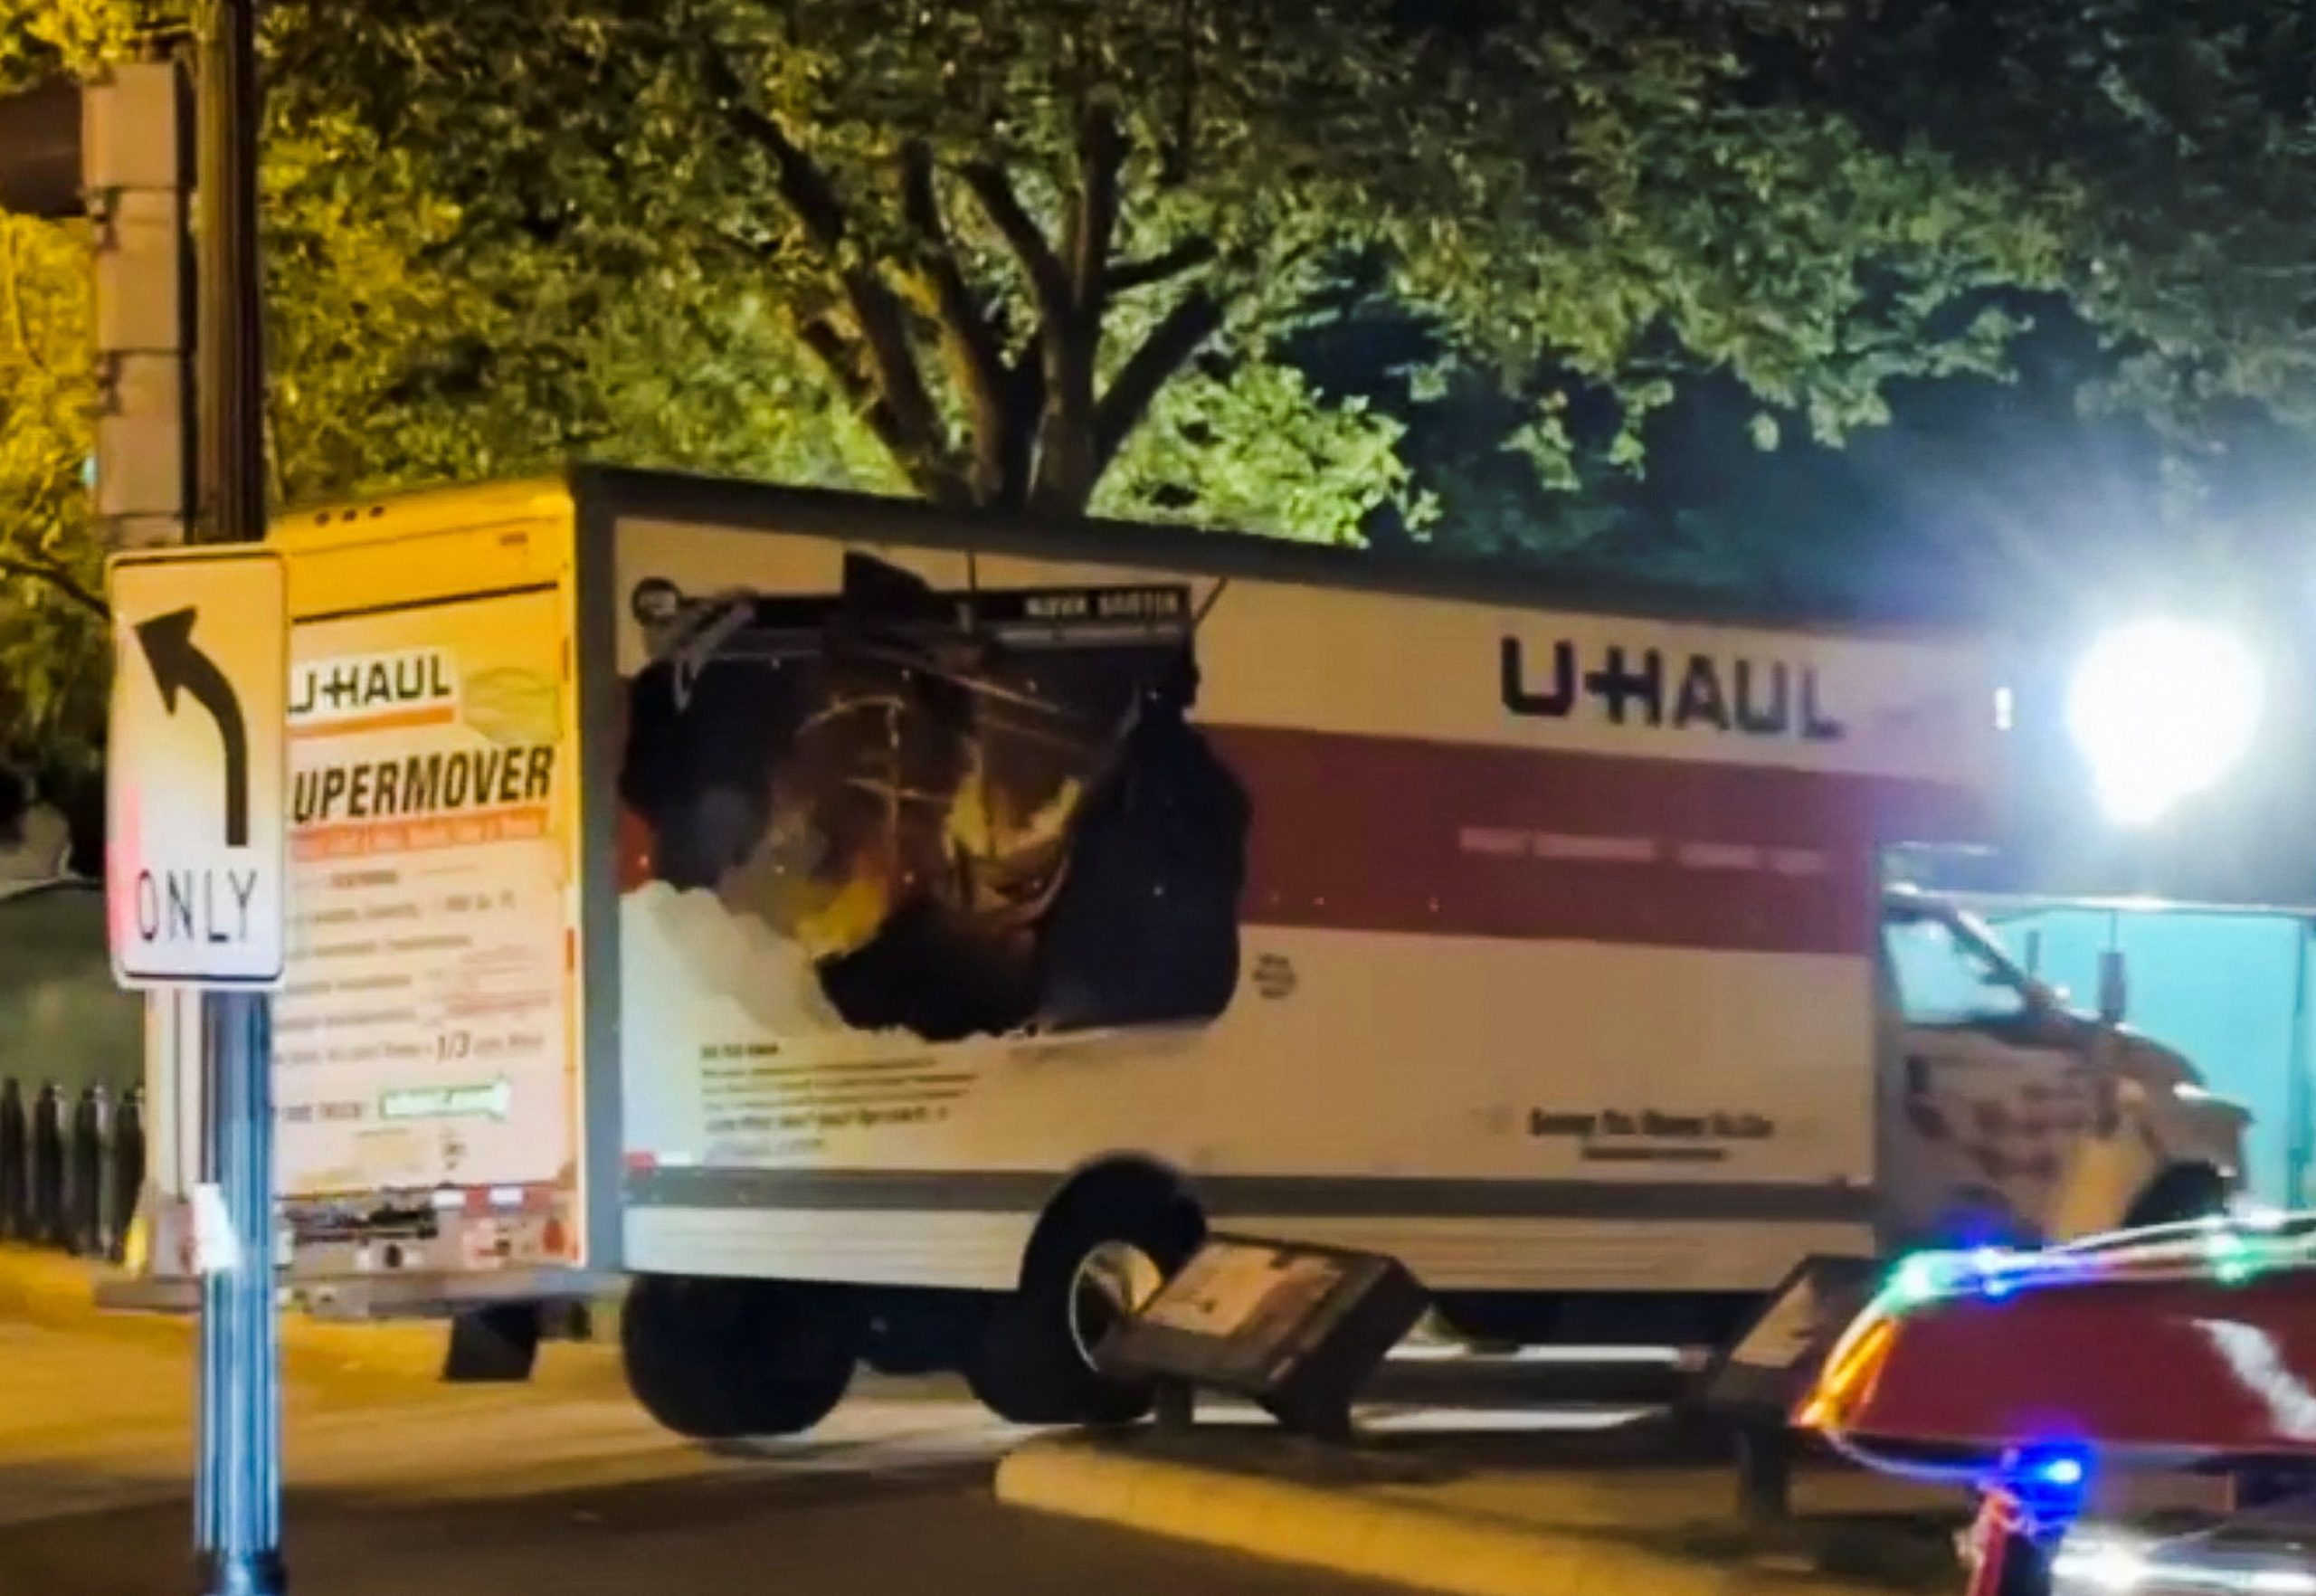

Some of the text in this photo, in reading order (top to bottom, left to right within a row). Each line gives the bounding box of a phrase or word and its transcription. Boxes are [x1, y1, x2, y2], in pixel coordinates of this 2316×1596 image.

[1501, 636, 1843, 739] U-HAUL
[294, 746, 555, 825] UPERMOVER
[136, 869, 259, 943] ONLY
